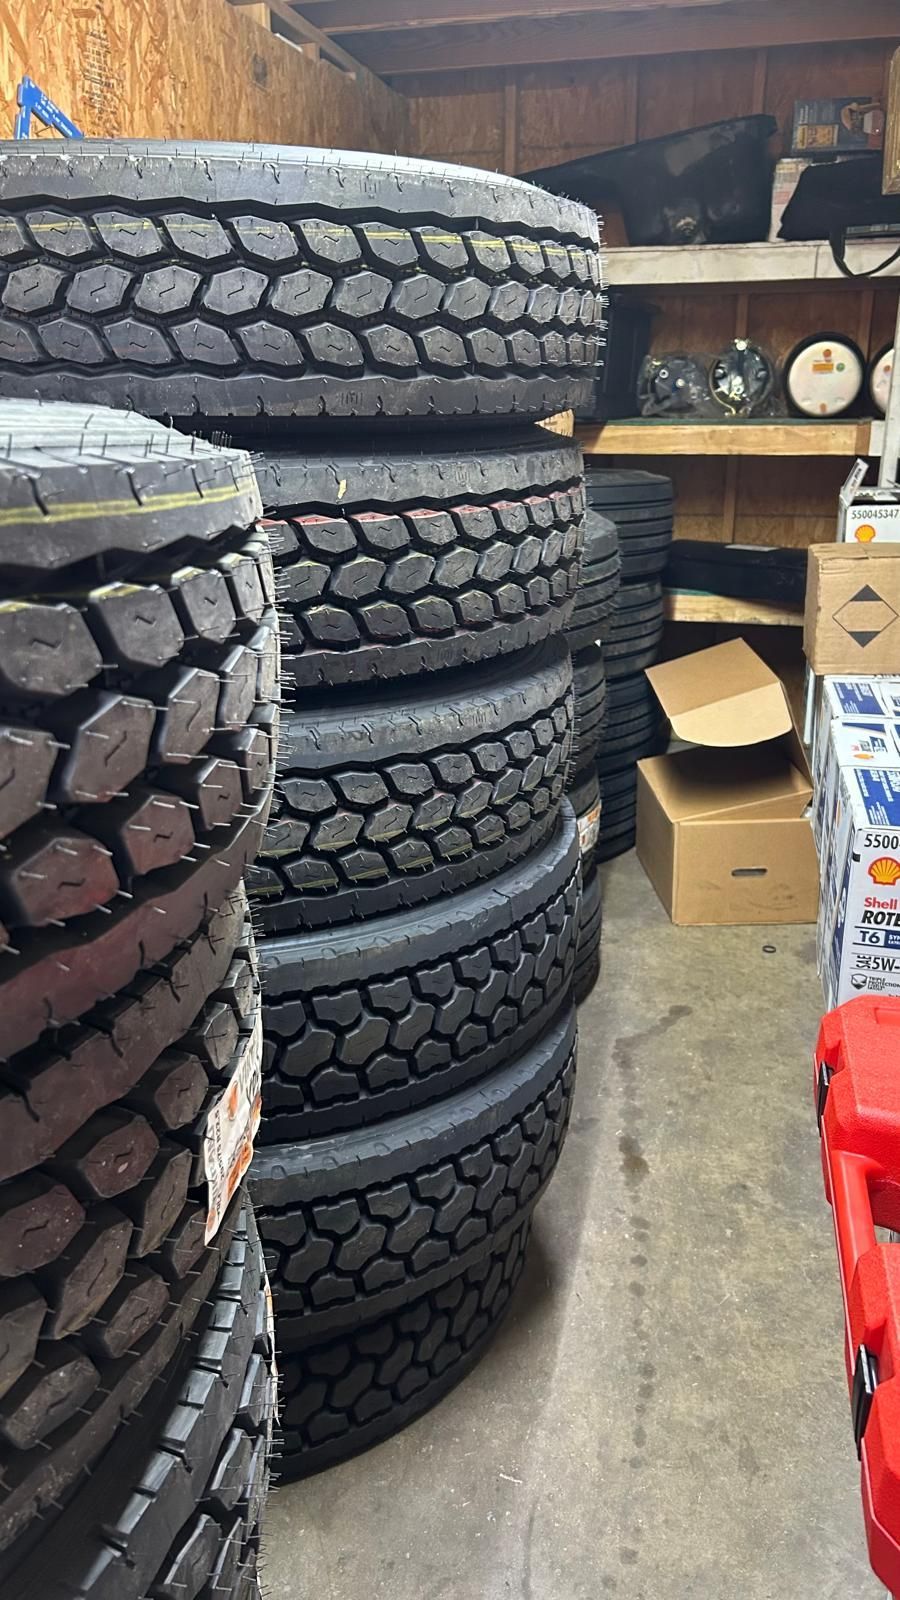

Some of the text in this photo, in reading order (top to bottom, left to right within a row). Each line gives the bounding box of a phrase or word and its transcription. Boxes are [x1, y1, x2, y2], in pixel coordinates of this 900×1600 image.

[851, 509, 900, 520] 550045347
[864, 833, 900, 849] 5500
[864, 896, 897, 910] Shell
[860, 930, 880, 944] T6
[856, 955, 871, 969] SAE
